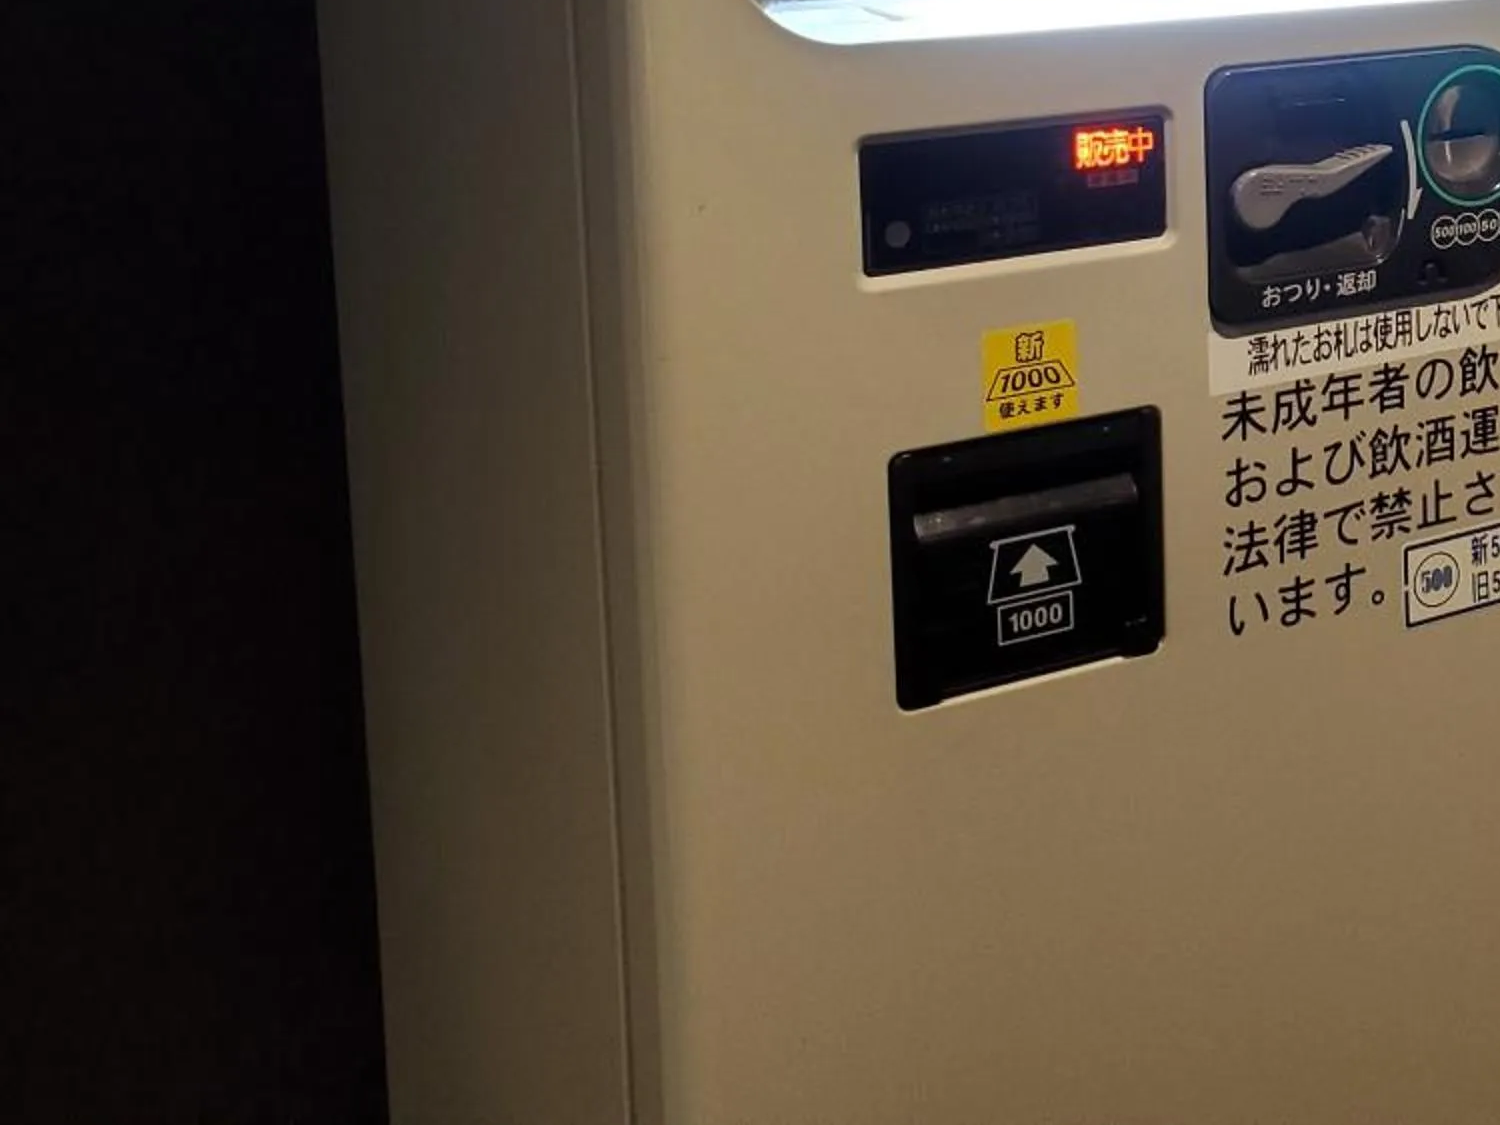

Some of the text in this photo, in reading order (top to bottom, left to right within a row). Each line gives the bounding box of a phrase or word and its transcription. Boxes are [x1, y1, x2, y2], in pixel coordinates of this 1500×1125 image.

[1076, 127, 1153, 170] 販売中
[1481, 218, 1497, 232] 50
[1262, 270, 1377, 308] おつり・返却
[1015, 330, 1044, 363] 新
[1000, 366, 1061, 393] 1000
[1000, 392, 1064, 419] 使えます
[1421, 565, 1453, 594] 500
[1228, 563, 1385, 636] います。
[1008, 602, 1063, 634] 1000
